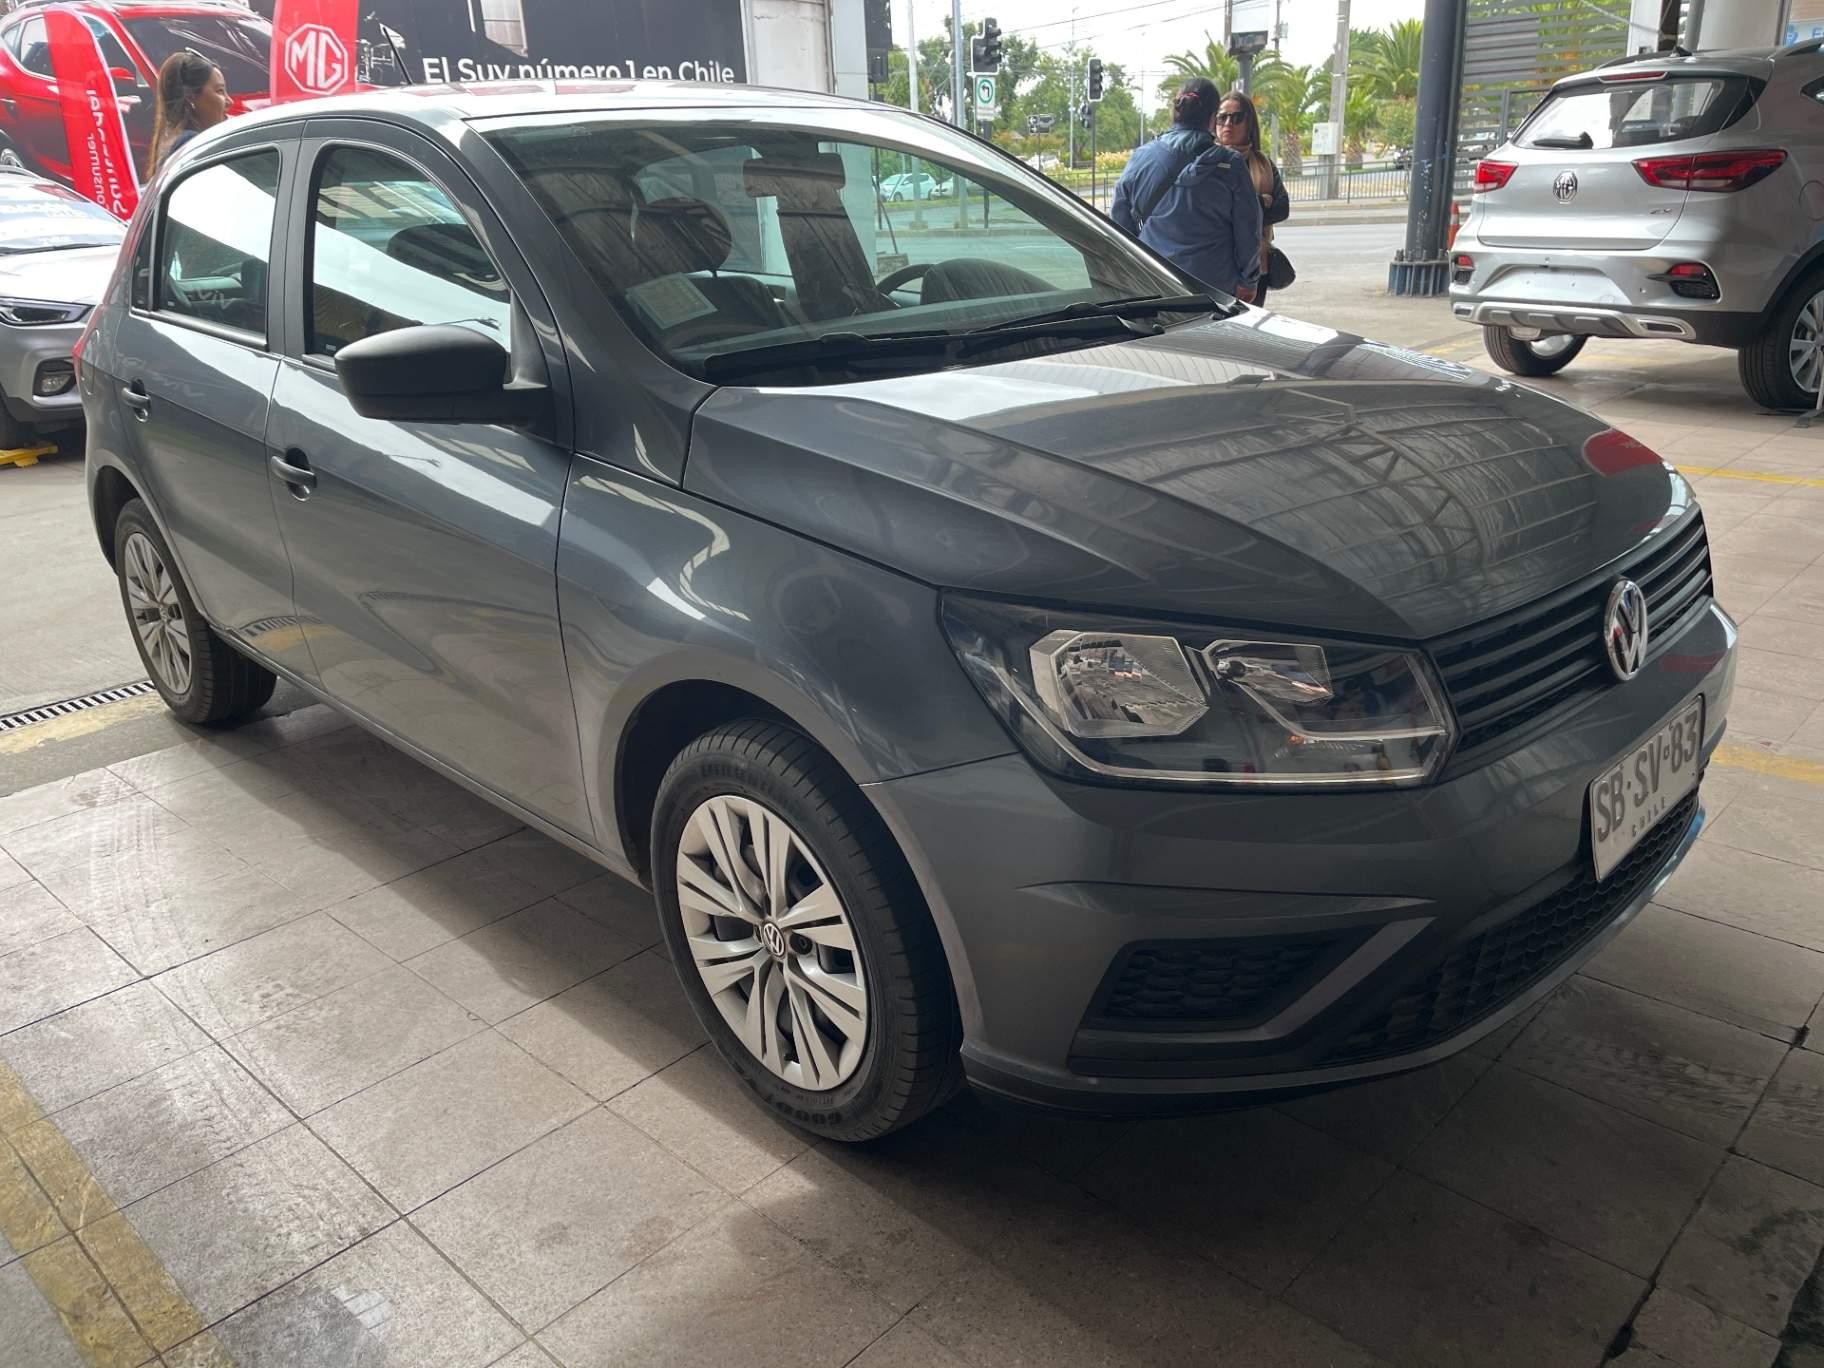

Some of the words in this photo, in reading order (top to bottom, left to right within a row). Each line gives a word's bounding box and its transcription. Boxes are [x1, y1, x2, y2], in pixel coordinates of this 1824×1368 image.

[289, 29, 343, 90] MG
[422, 57, 450, 83] El
[457, 58, 510, 81] Suv
[518, 58, 622, 79] número
[625, 60, 636, 79] 1
[643, 65, 672, 80] en
[678, 60, 735, 83] Chile
